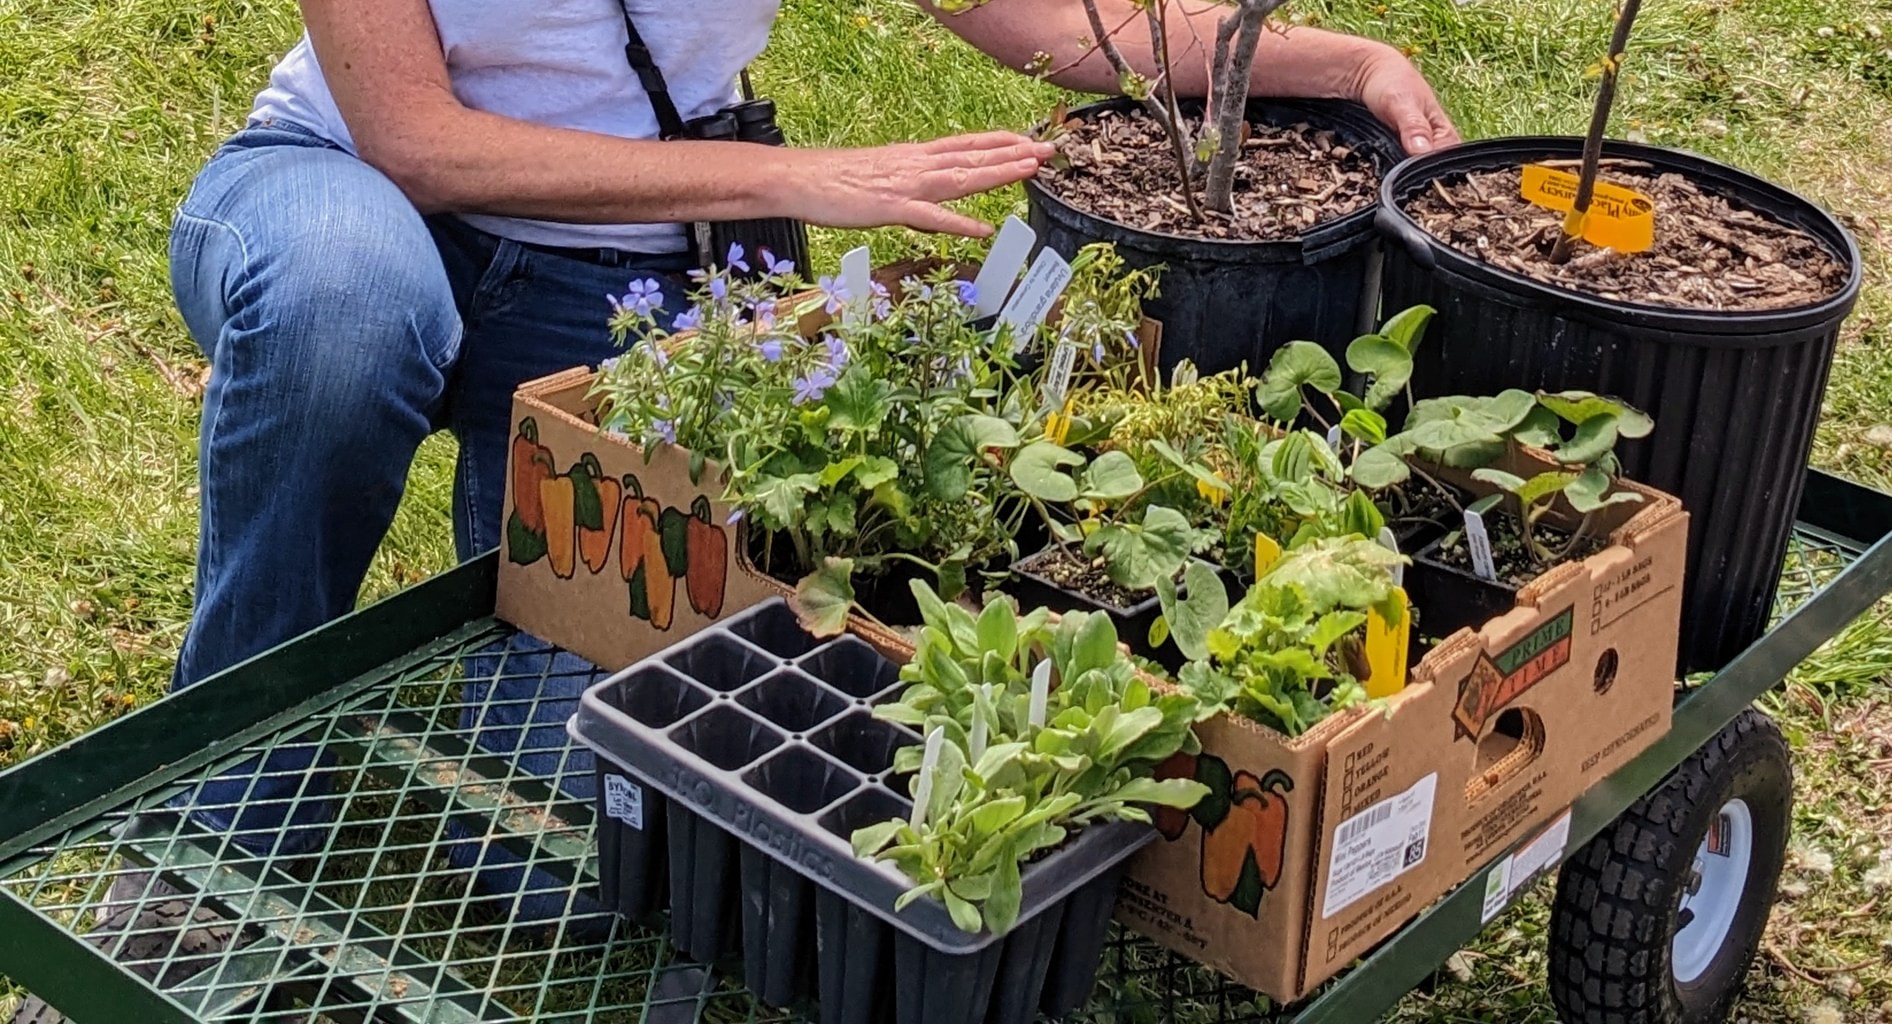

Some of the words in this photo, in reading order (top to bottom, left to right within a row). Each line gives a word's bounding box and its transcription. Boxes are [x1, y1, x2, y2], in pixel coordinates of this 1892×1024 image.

[1511, 619, 1564, 666] PRIME
[1510, 645, 1561, 692] TIME
[1356, 747, 1390, 779] YELLOW
[1357, 742, 1374, 760] RED
[1354, 765, 1390, 797] ORANGE
[1354, 788, 1381, 812] MIXED
[1154, 890, 1168, 904] AT
